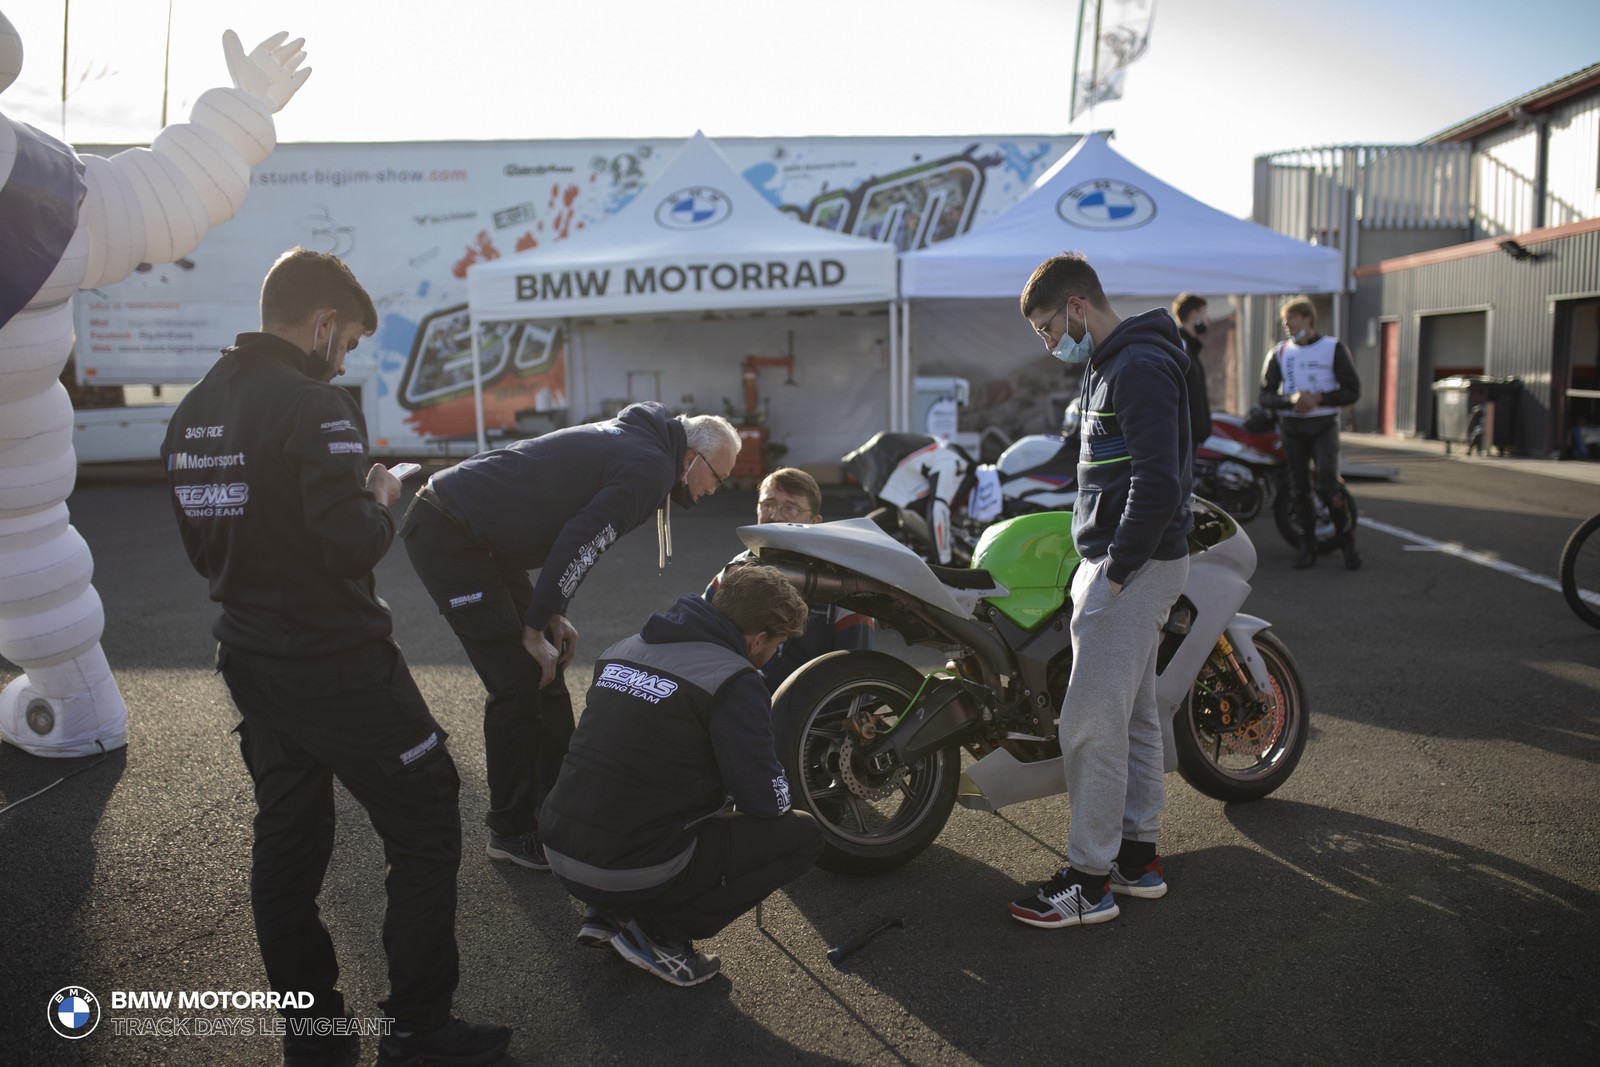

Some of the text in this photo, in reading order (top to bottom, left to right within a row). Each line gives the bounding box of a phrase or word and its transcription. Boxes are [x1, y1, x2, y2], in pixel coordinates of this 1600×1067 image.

[515, 258, 847, 301] BMW MOTORRAD
[184, 425, 225, 439] 3ASY RIDE
[188, 452, 246, 469] Motorsport
[596, 680, 661, 704] RACING TEAM
